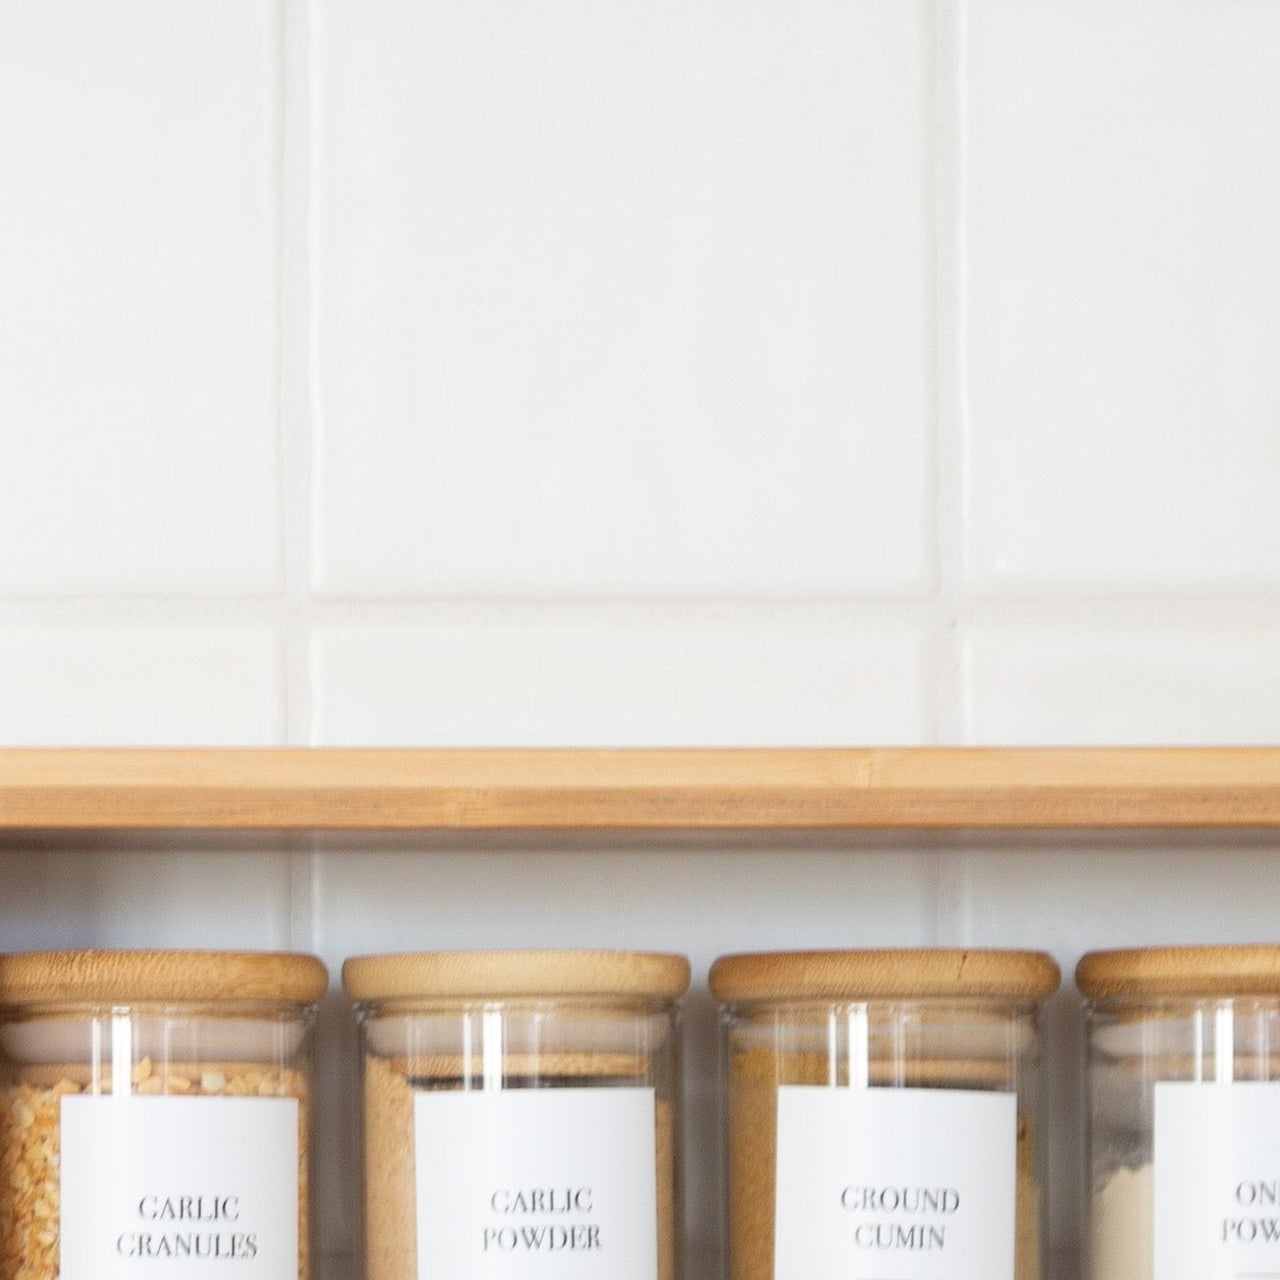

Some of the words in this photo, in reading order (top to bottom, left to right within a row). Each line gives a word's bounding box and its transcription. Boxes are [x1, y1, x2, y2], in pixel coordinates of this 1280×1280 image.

[138, 1196, 239, 1220] GARLIC
[491, 1188, 593, 1213] GARLIC
[841, 1188, 960, 1214] GROUND
[116, 1233, 258, 1258] GRANULES
[484, 1225, 601, 1250] POWDER
[855, 1224, 946, 1251] CUMIN
